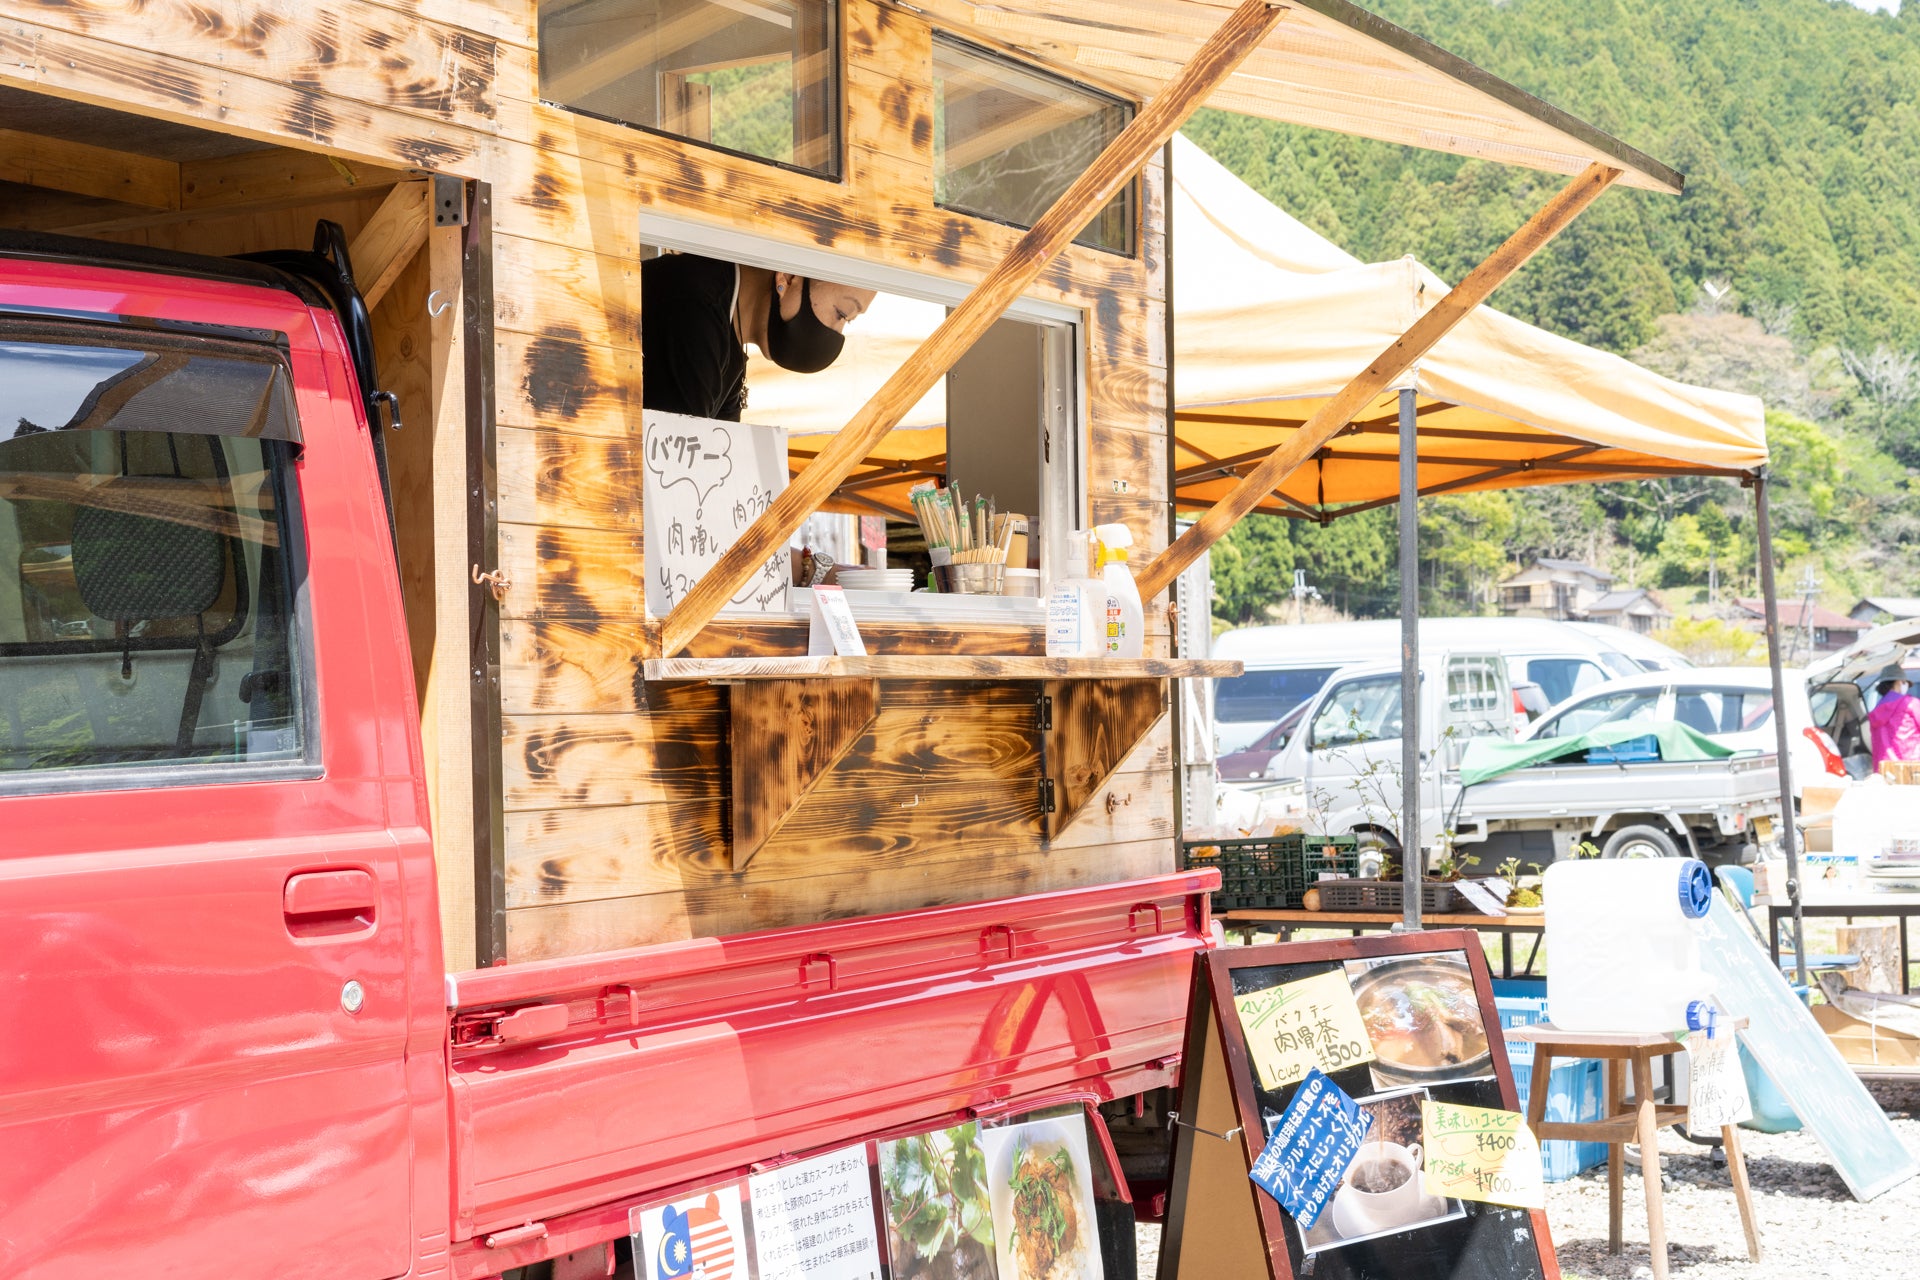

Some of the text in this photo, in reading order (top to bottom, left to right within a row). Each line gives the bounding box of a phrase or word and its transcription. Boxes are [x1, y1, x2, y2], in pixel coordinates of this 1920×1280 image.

[651, 435, 720, 469] バクテー
[733, 485, 773, 529] 肉プラス
[668, 516, 718, 556] 肉増し
[1275, 1004, 1333, 1027] バクテー
[1274, 1018, 1340, 1053] 肉骨茶
[1257, 1079, 1322, 1182] 当店の珈琲は良質の
[1435, 1105, 1518, 1130] 美味しいコーヒー
[1292, 1109, 1349, 1200] ベースにじっくり
